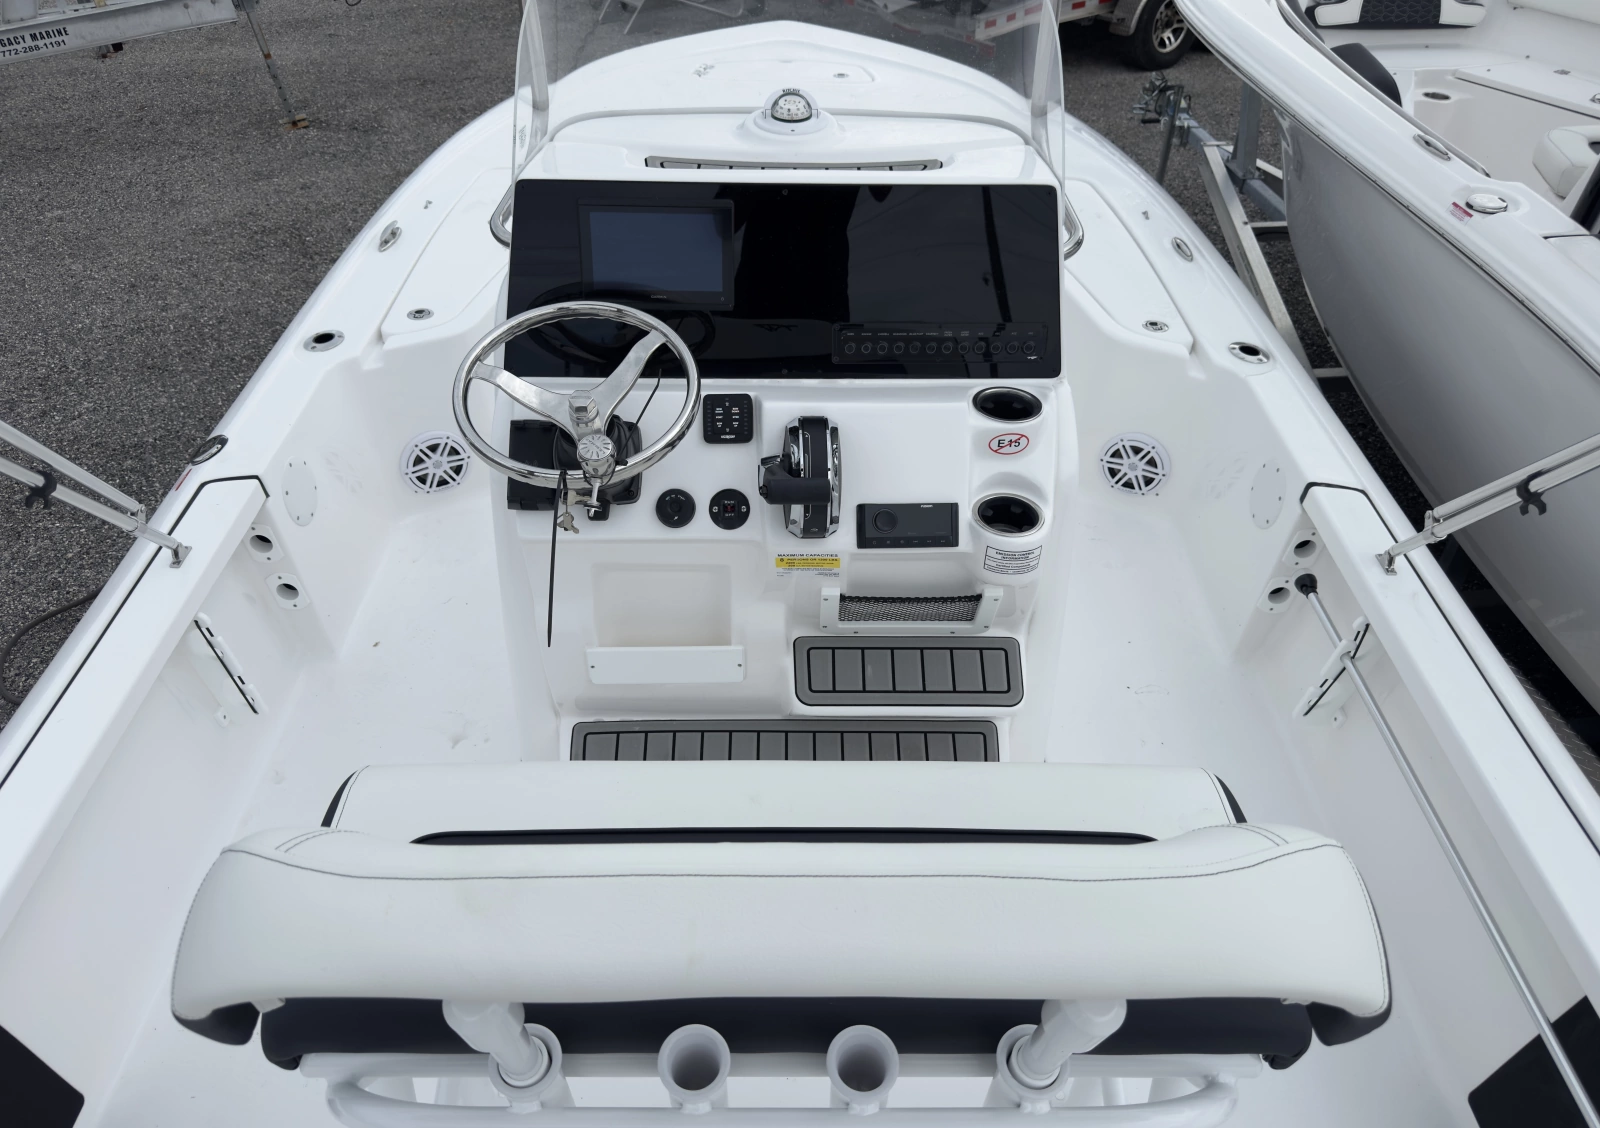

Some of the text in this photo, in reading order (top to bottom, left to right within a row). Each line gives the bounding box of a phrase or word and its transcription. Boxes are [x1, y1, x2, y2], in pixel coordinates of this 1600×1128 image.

[0, 27, 69, 48] GACY MARINE
[1, 39, 67, 57] 772-288-1191
